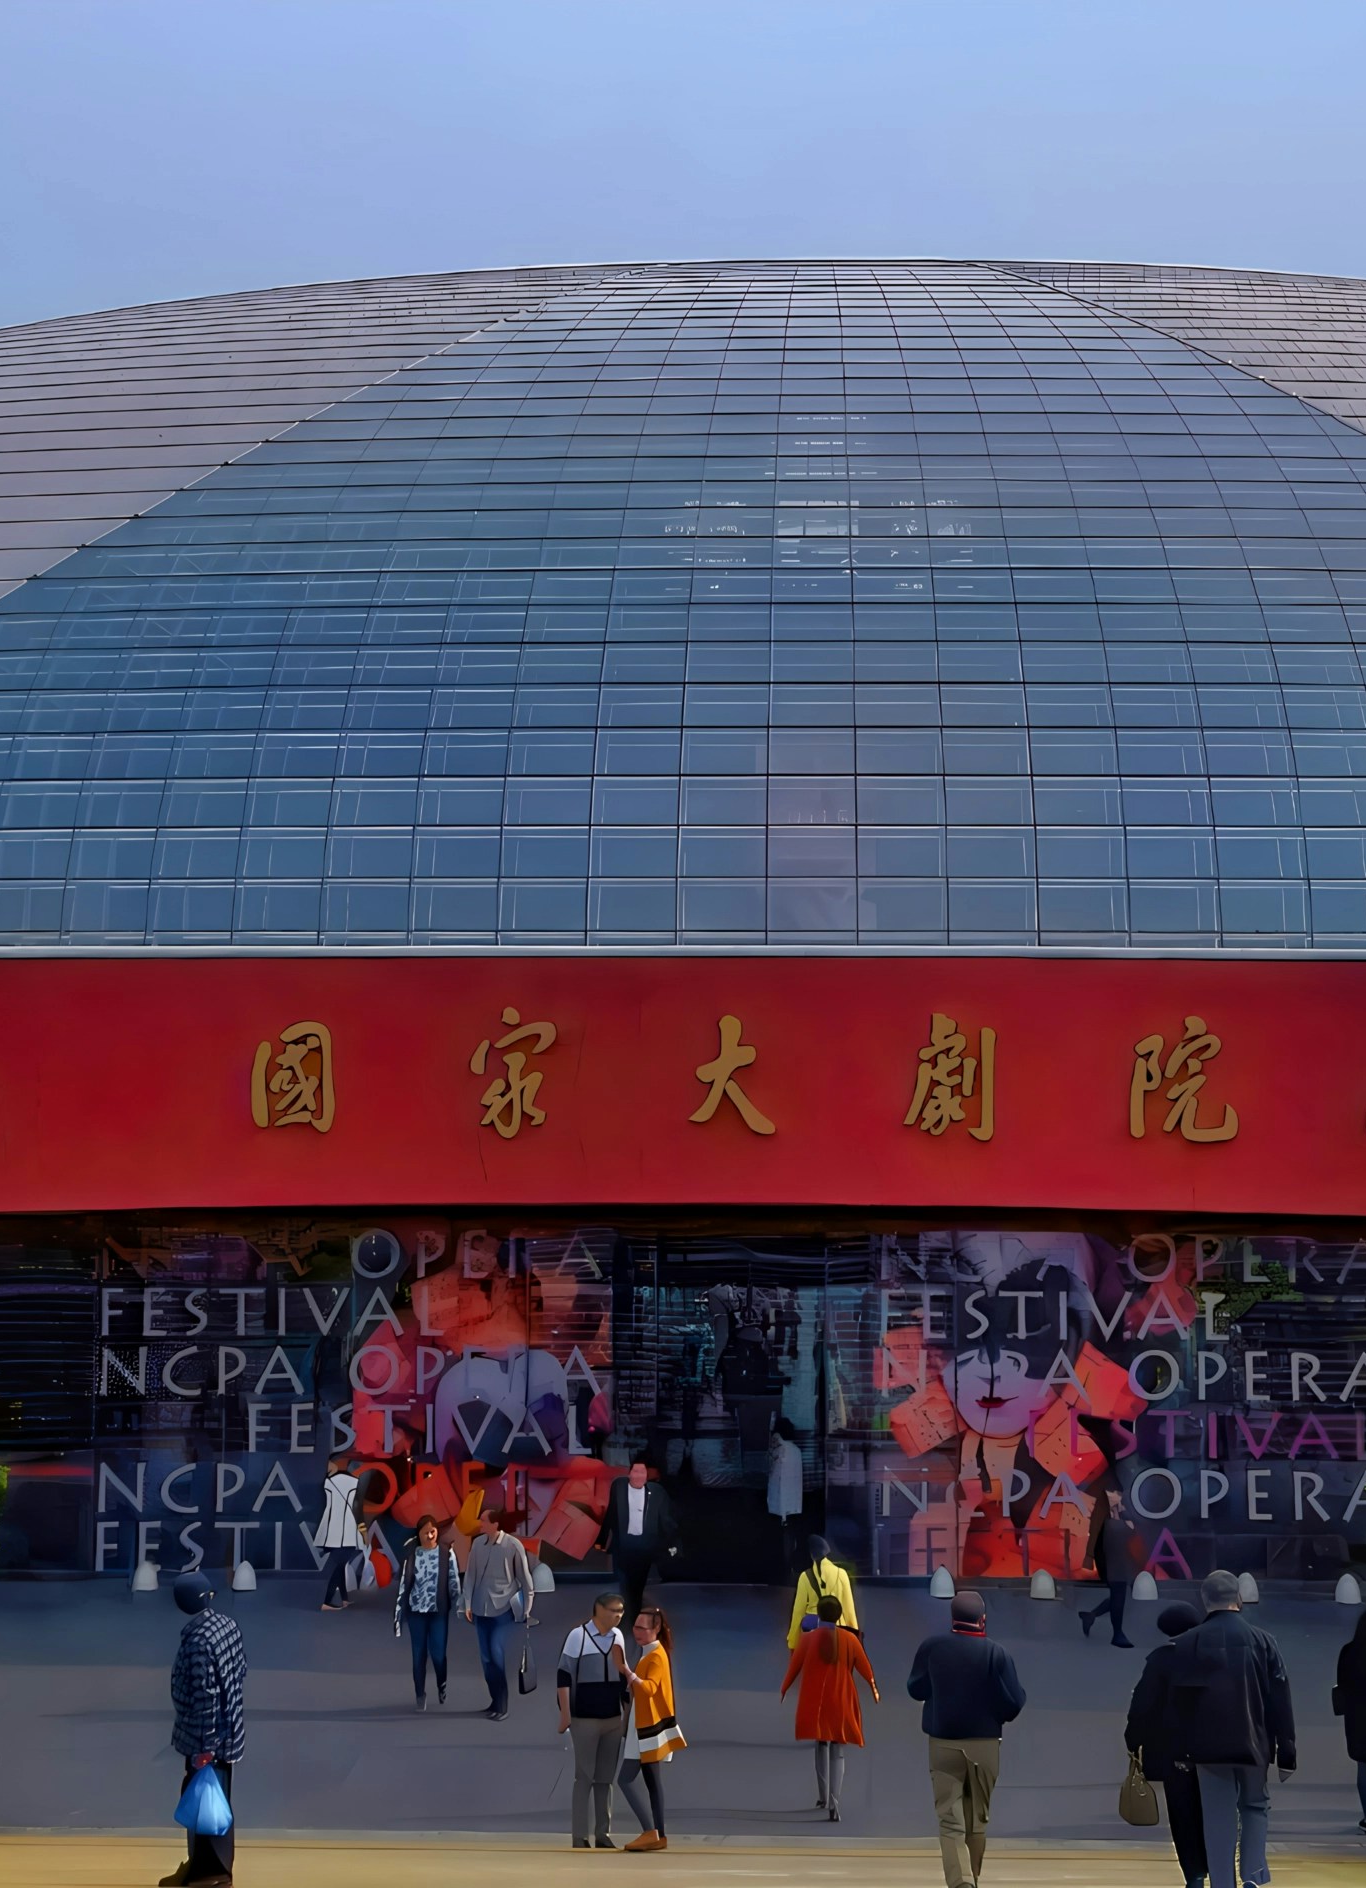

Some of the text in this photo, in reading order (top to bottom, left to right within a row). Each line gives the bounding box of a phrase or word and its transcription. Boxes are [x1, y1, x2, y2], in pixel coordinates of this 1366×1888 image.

[250, 1006, 1239, 1145] 國家大劇院
[101, 1286, 446, 1337] FESTIVAL
[881, 1289, 1231, 1342] FESTIVAL
[98, 1343, 604, 1398] NCPA OPA
[881, 1347, 1093, 1402] NA
[248, 1401, 593, 1455] FESTIVAL
[97, 1461, 303, 1514] NCPA
[95, 1520, 401, 1573] FESTIVA
